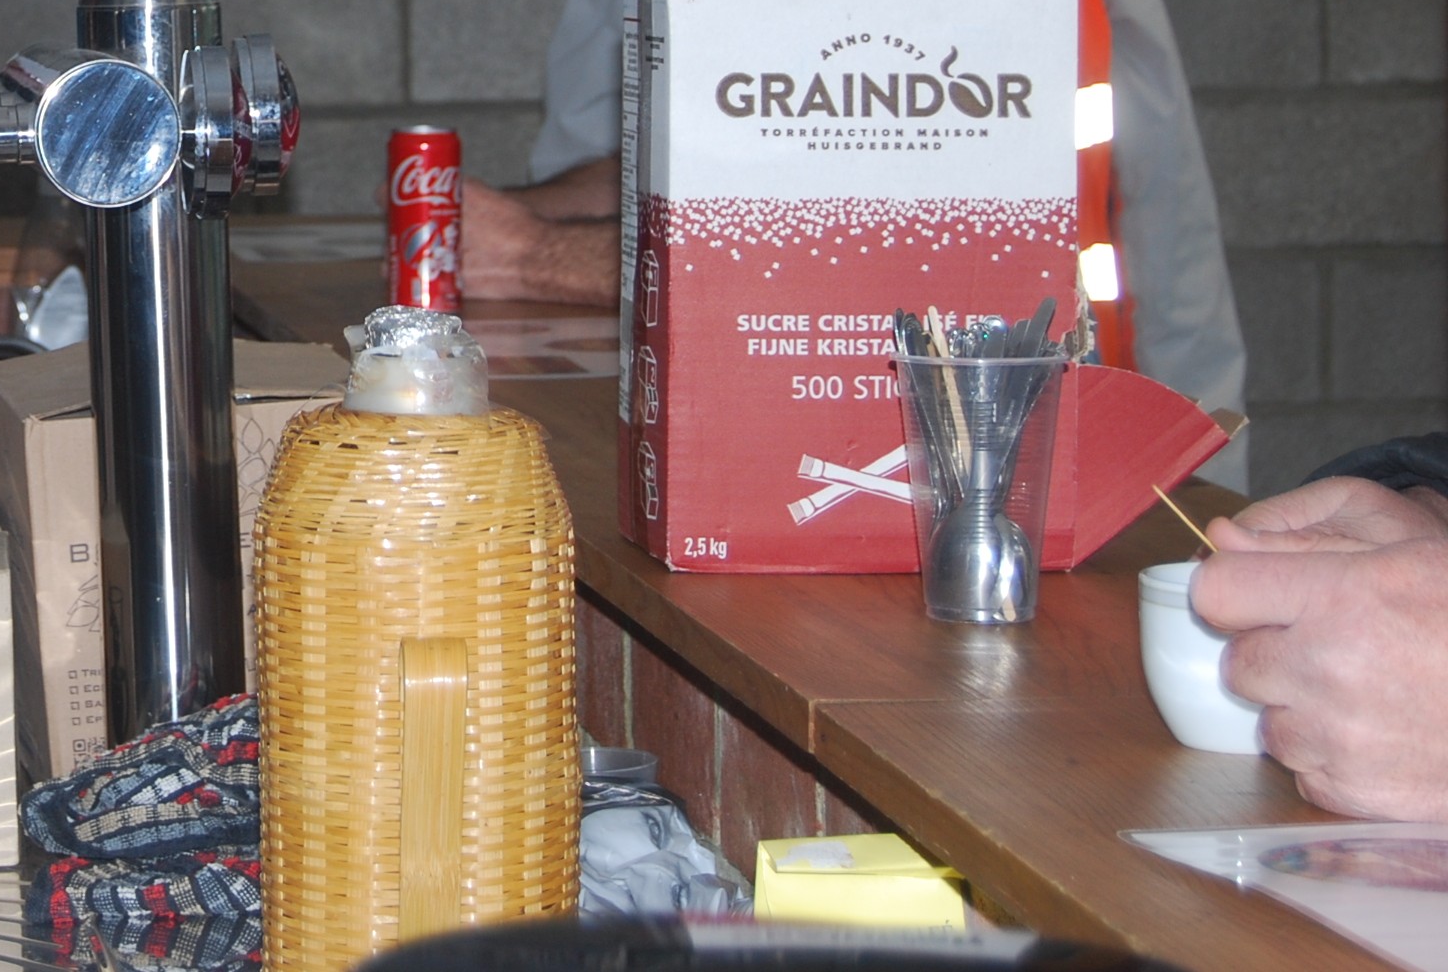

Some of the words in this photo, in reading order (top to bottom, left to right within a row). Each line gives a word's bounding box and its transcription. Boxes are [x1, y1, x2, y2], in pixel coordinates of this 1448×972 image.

[820, 33, 872, 60] ANNO
[883, 34, 926, 61] 1937
[760, 127, 904, 137] TORRÉFACTION
[917, 128, 989, 137] MAISON
[807, 142, 943, 151] HUISGEBRAND
[736, 314, 811, 332] SUCRE
[747, 339, 809, 356] FIJNE
[817, 339, 896, 356] KRISTA
[791, 375, 844, 400] 500
[684, 537, 707, 558] 2,5
[709, 537, 728, 560] kg
